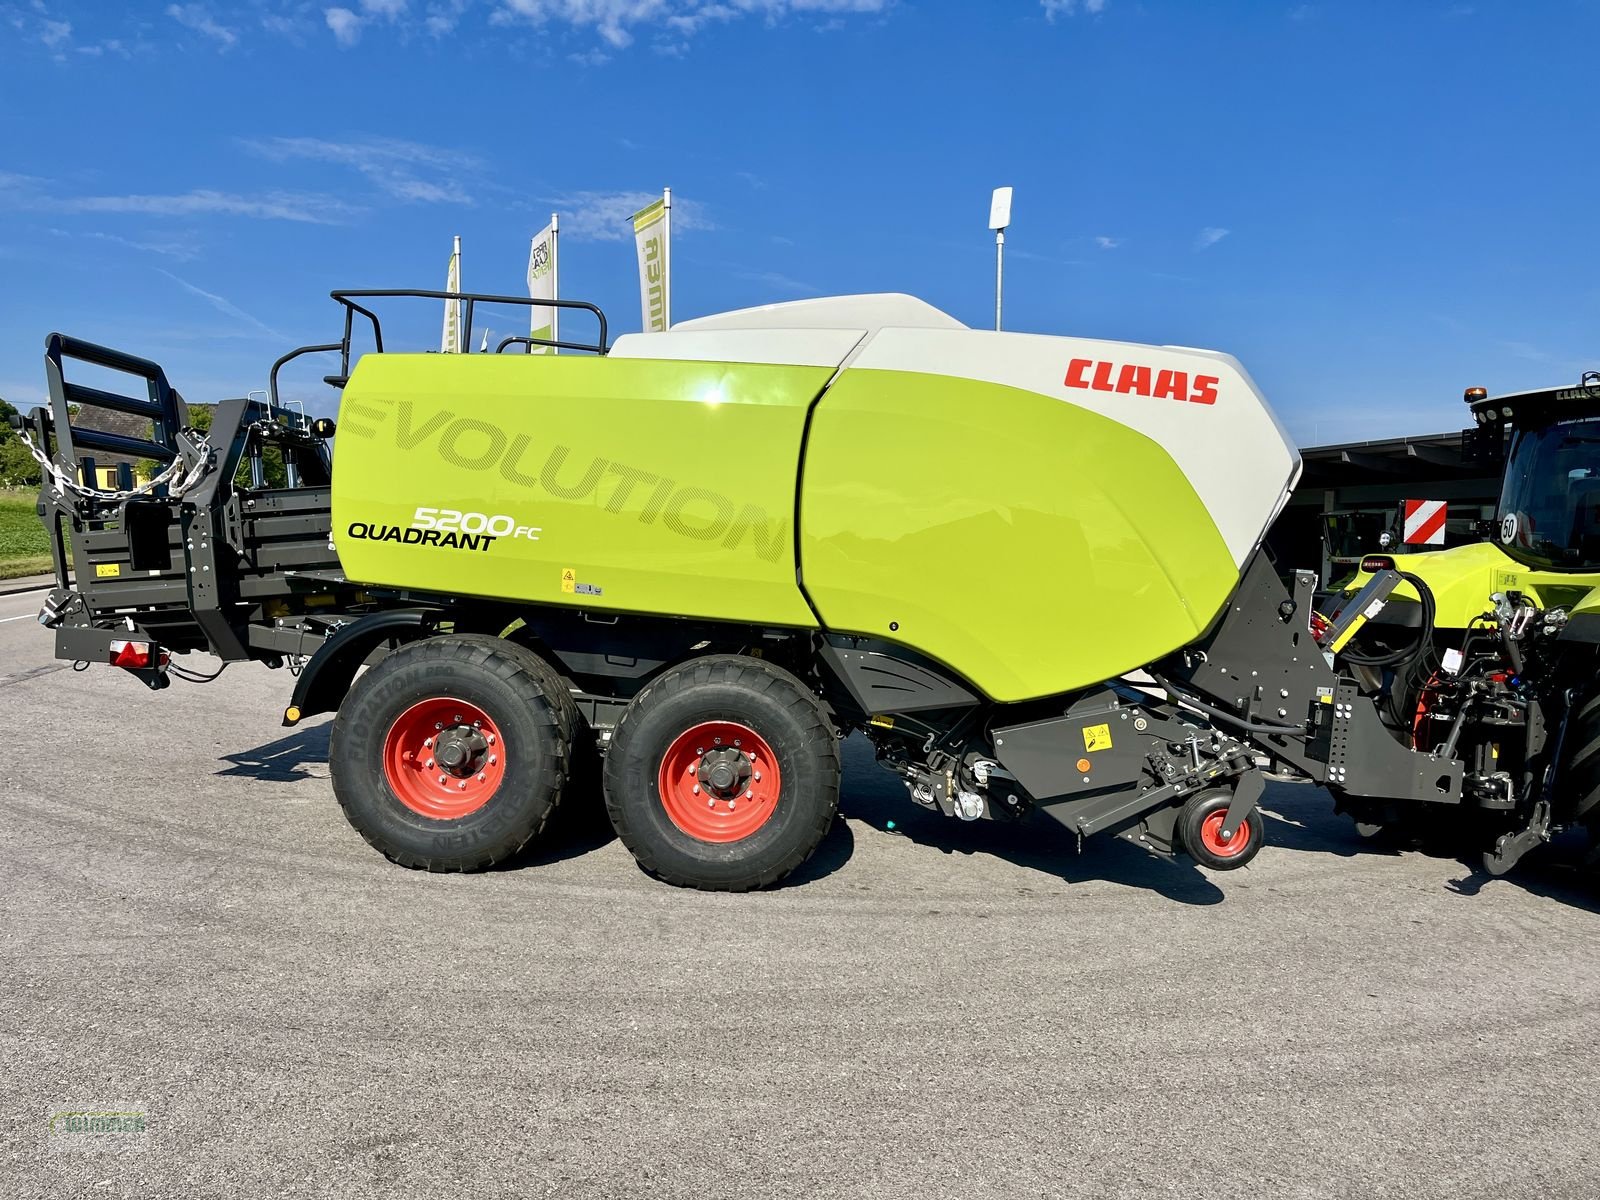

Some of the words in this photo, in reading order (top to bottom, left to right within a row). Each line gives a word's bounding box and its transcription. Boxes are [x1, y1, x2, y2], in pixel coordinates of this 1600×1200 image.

[1064, 358, 1219, 405] CLAAS
[341, 397, 787, 564] EVOLUTION
[348, 522, 497, 552] QUADRANT
[411, 507, 515, 537] 5200
[513, 526, 543, 540] FC
[1503, 519, 1514, 539] 50
